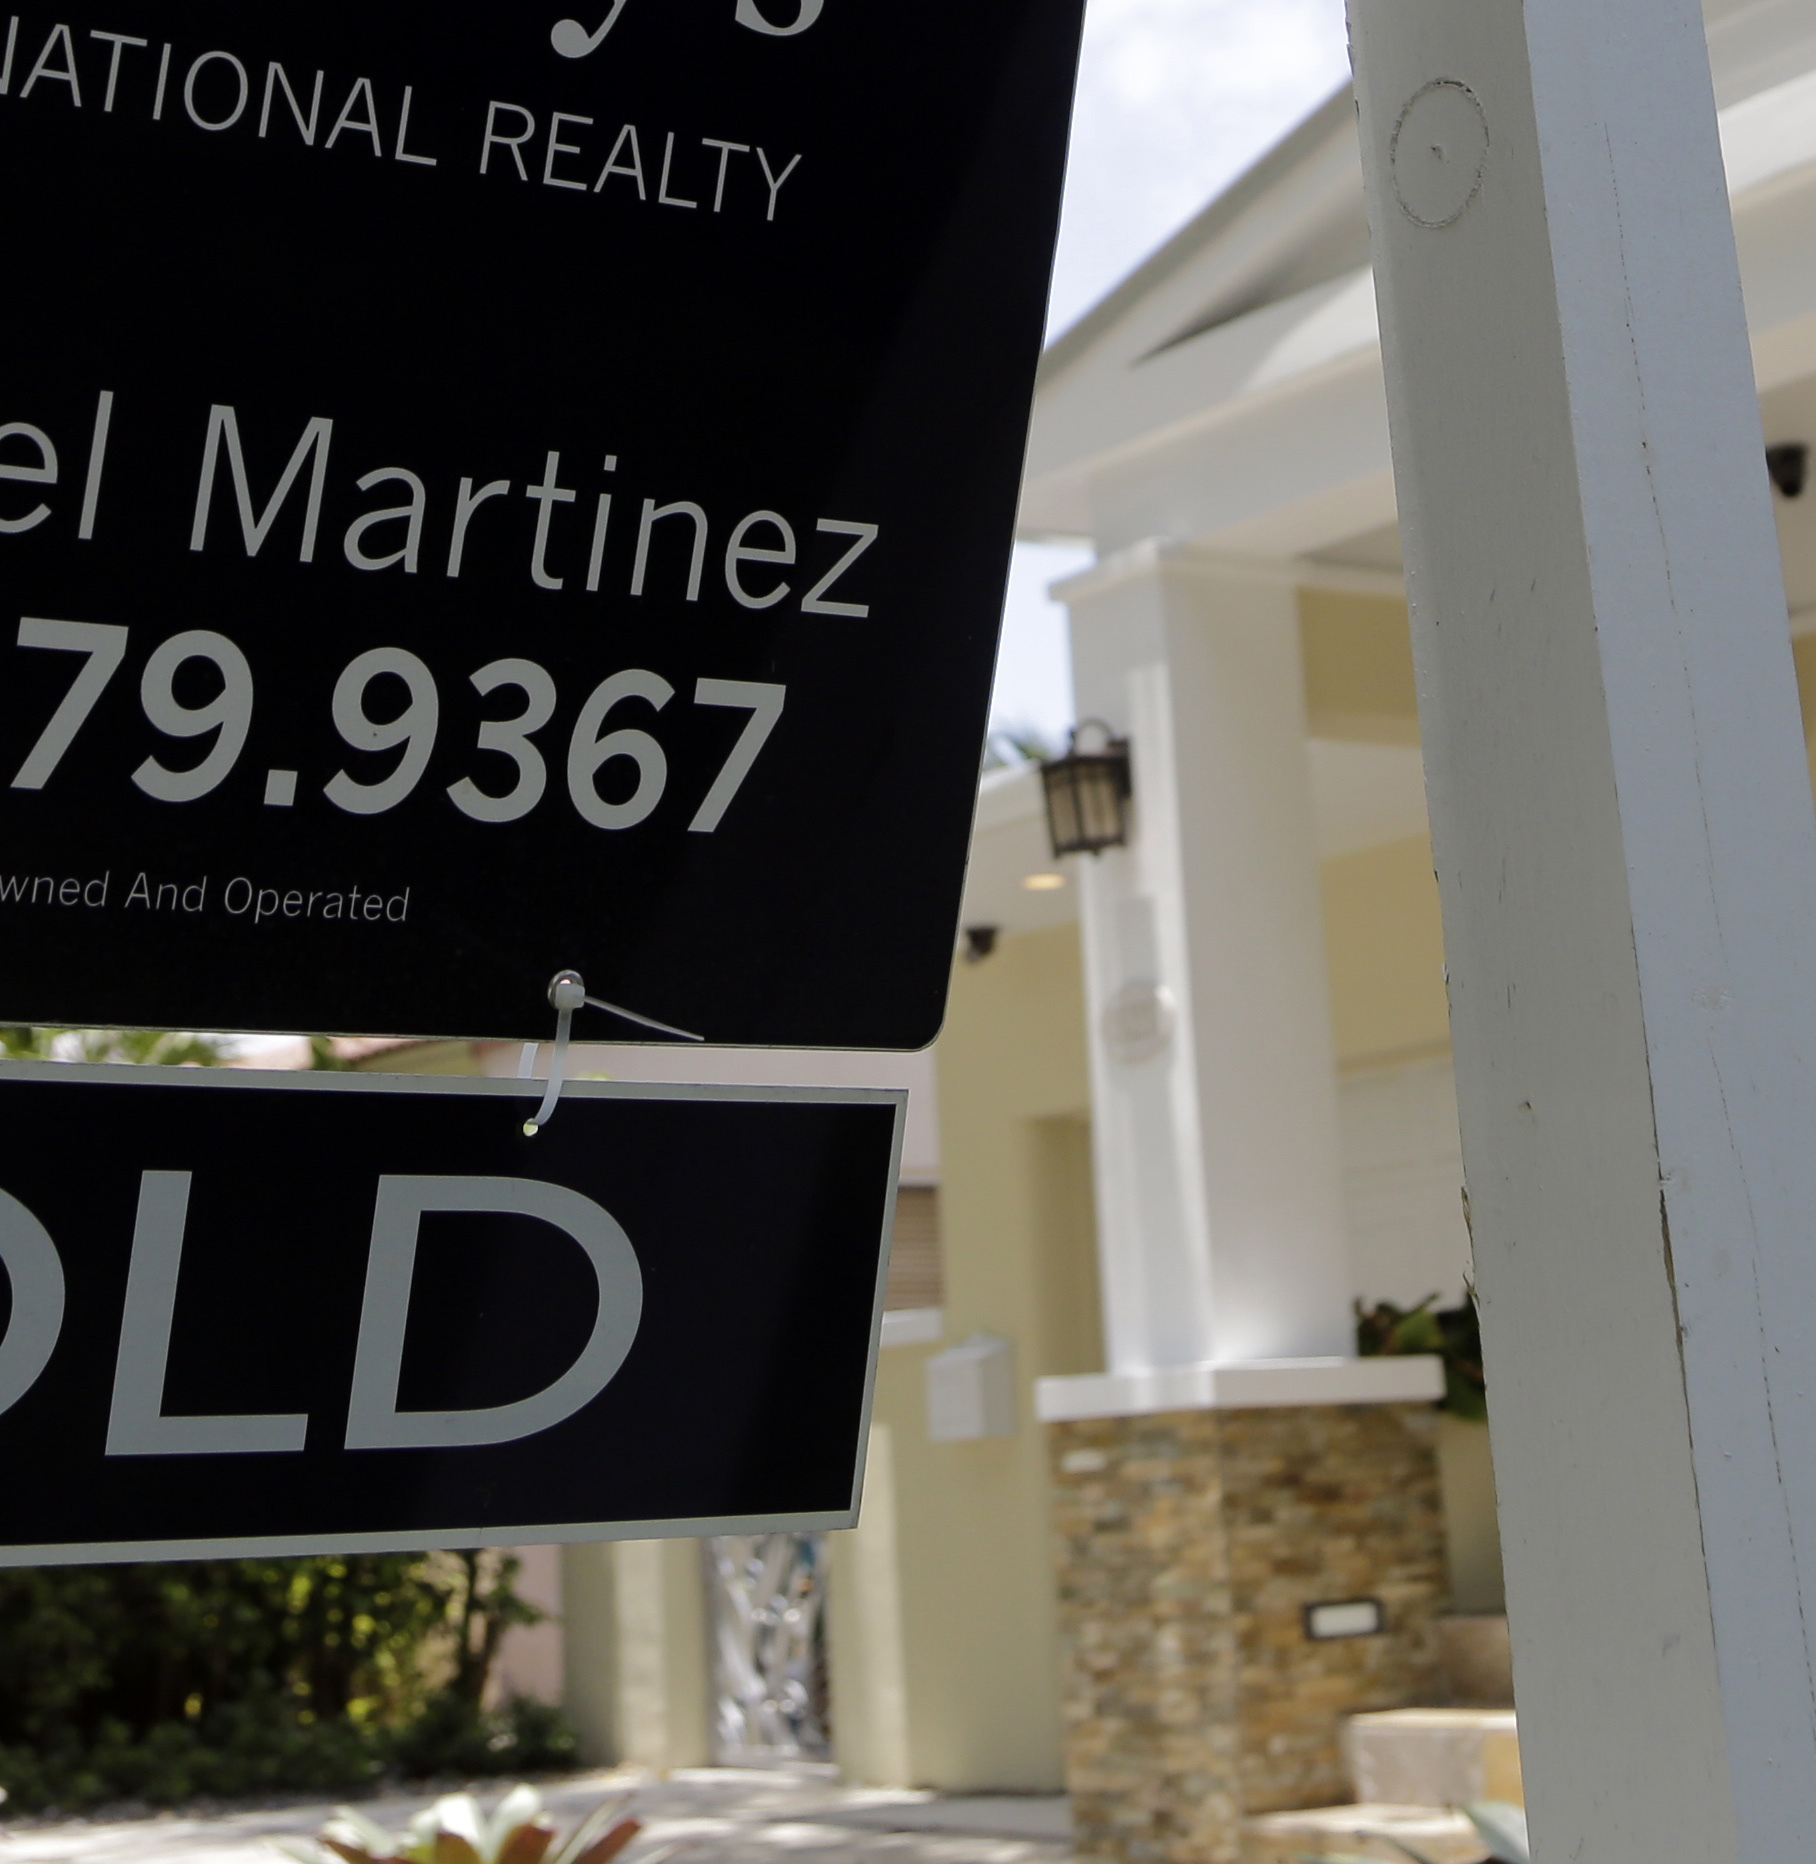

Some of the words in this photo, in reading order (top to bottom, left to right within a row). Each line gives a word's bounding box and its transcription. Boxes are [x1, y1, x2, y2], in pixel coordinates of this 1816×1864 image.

[478, 99, 803, 223] REALTY
[188, 402, 881, 621] Martinez
[122, 871, 208, 913] And
[222, 876, 411, 925] Operated
